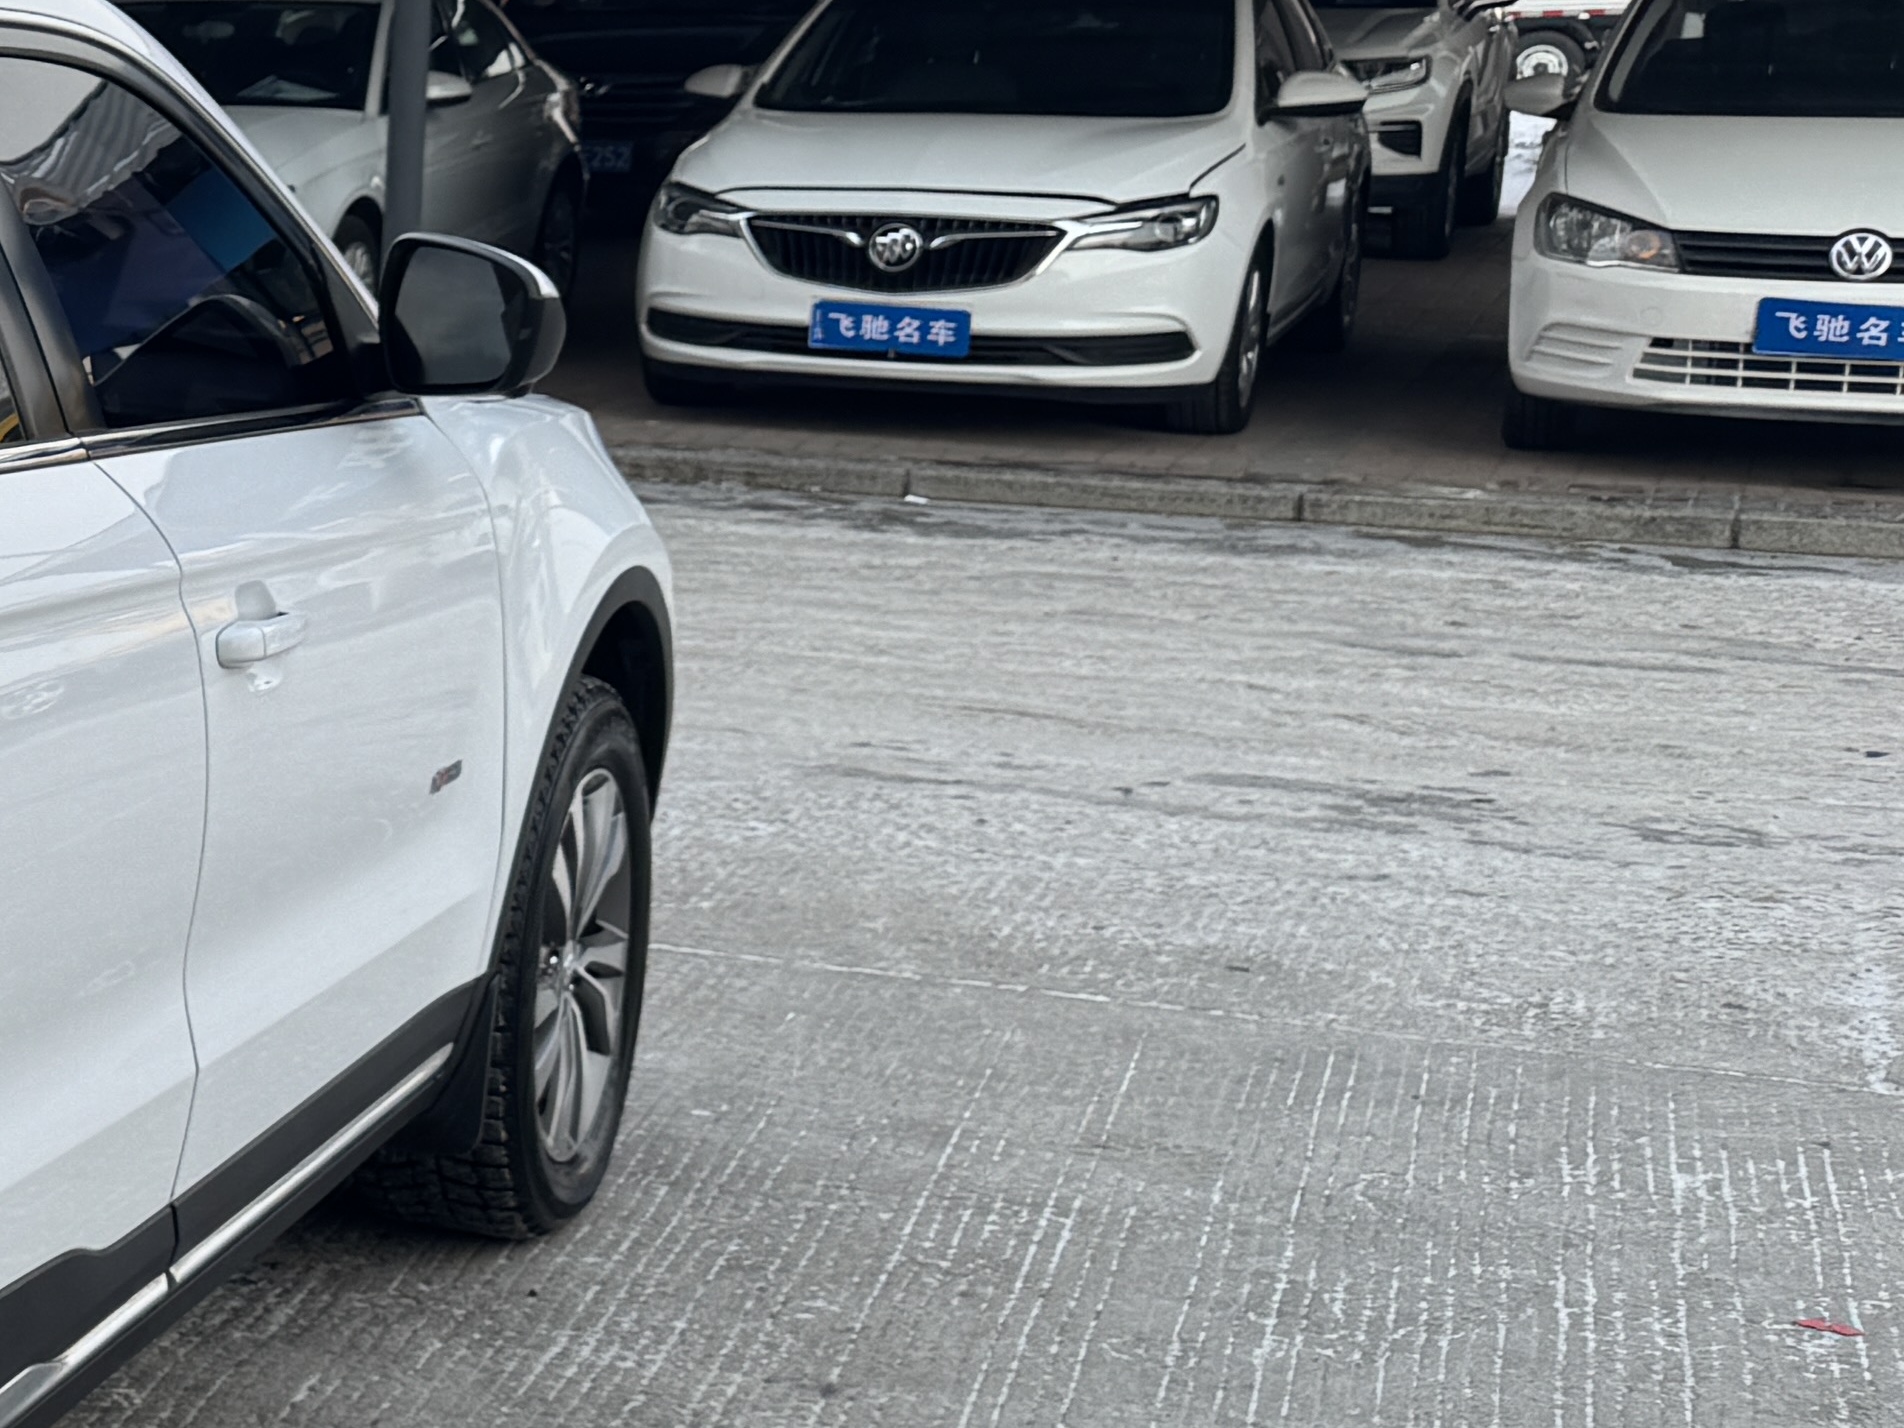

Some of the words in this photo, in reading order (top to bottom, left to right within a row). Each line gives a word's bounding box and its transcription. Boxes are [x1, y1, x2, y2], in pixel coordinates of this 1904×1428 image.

[827, 311, 958, 347] 飞驰名车
[1775, 311, 1904, 348] 飞驰名
